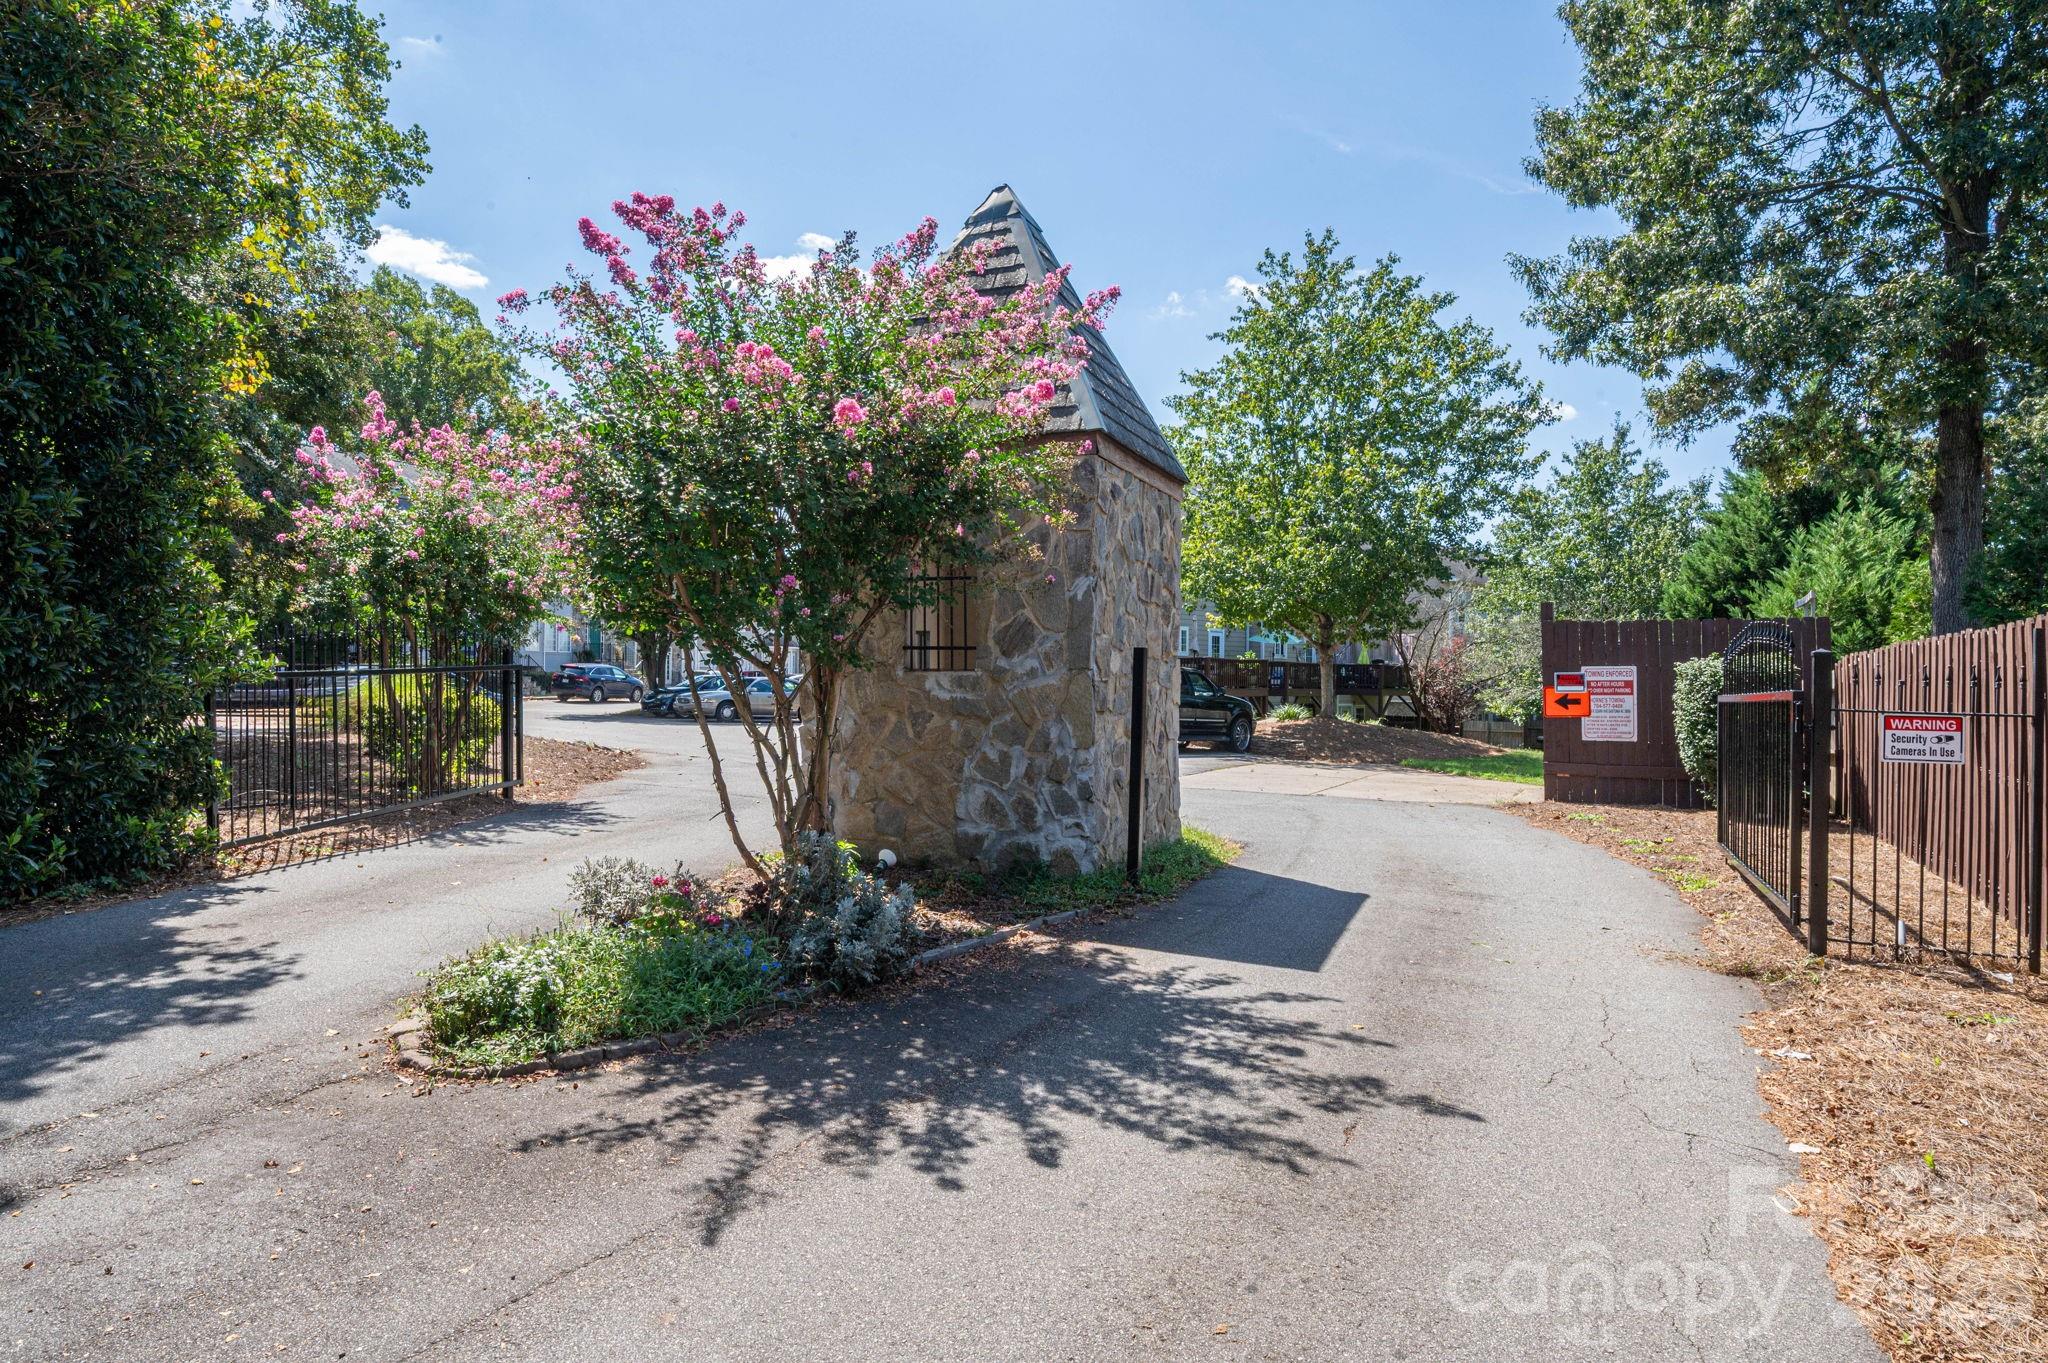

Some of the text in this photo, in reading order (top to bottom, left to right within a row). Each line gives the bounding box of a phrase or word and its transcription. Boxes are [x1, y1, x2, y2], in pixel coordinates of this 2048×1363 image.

[1890, 719, 1957, 730] WARNING
[1891, 733, 1928, 746] Security
[1891, 745, 1955, 757] Cameras In Use
